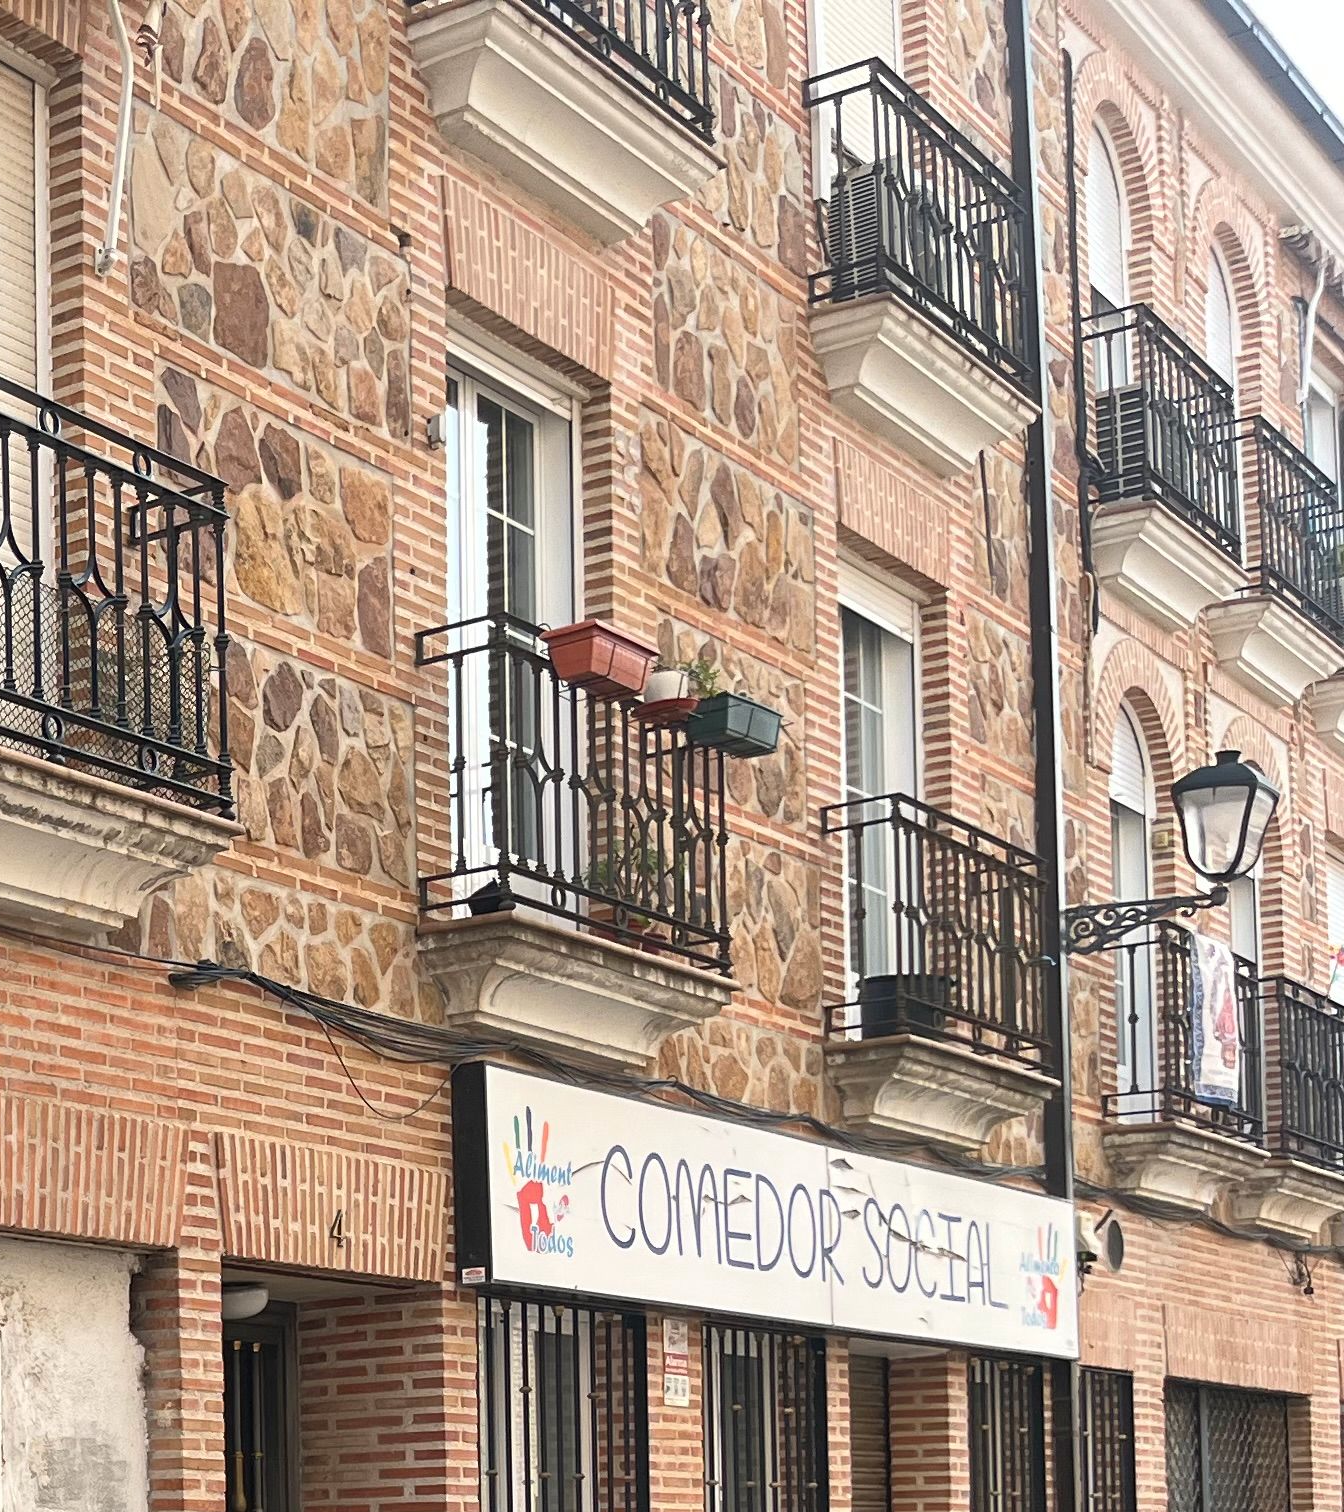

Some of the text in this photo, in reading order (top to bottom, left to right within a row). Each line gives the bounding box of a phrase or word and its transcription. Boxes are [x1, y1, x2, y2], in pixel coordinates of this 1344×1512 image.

[328, 1208, 346, 1249] 4
[531, 1225, 574, 1258] Todos
[600, 1144, 1009, 1309] COMEDOR SOCIAL
